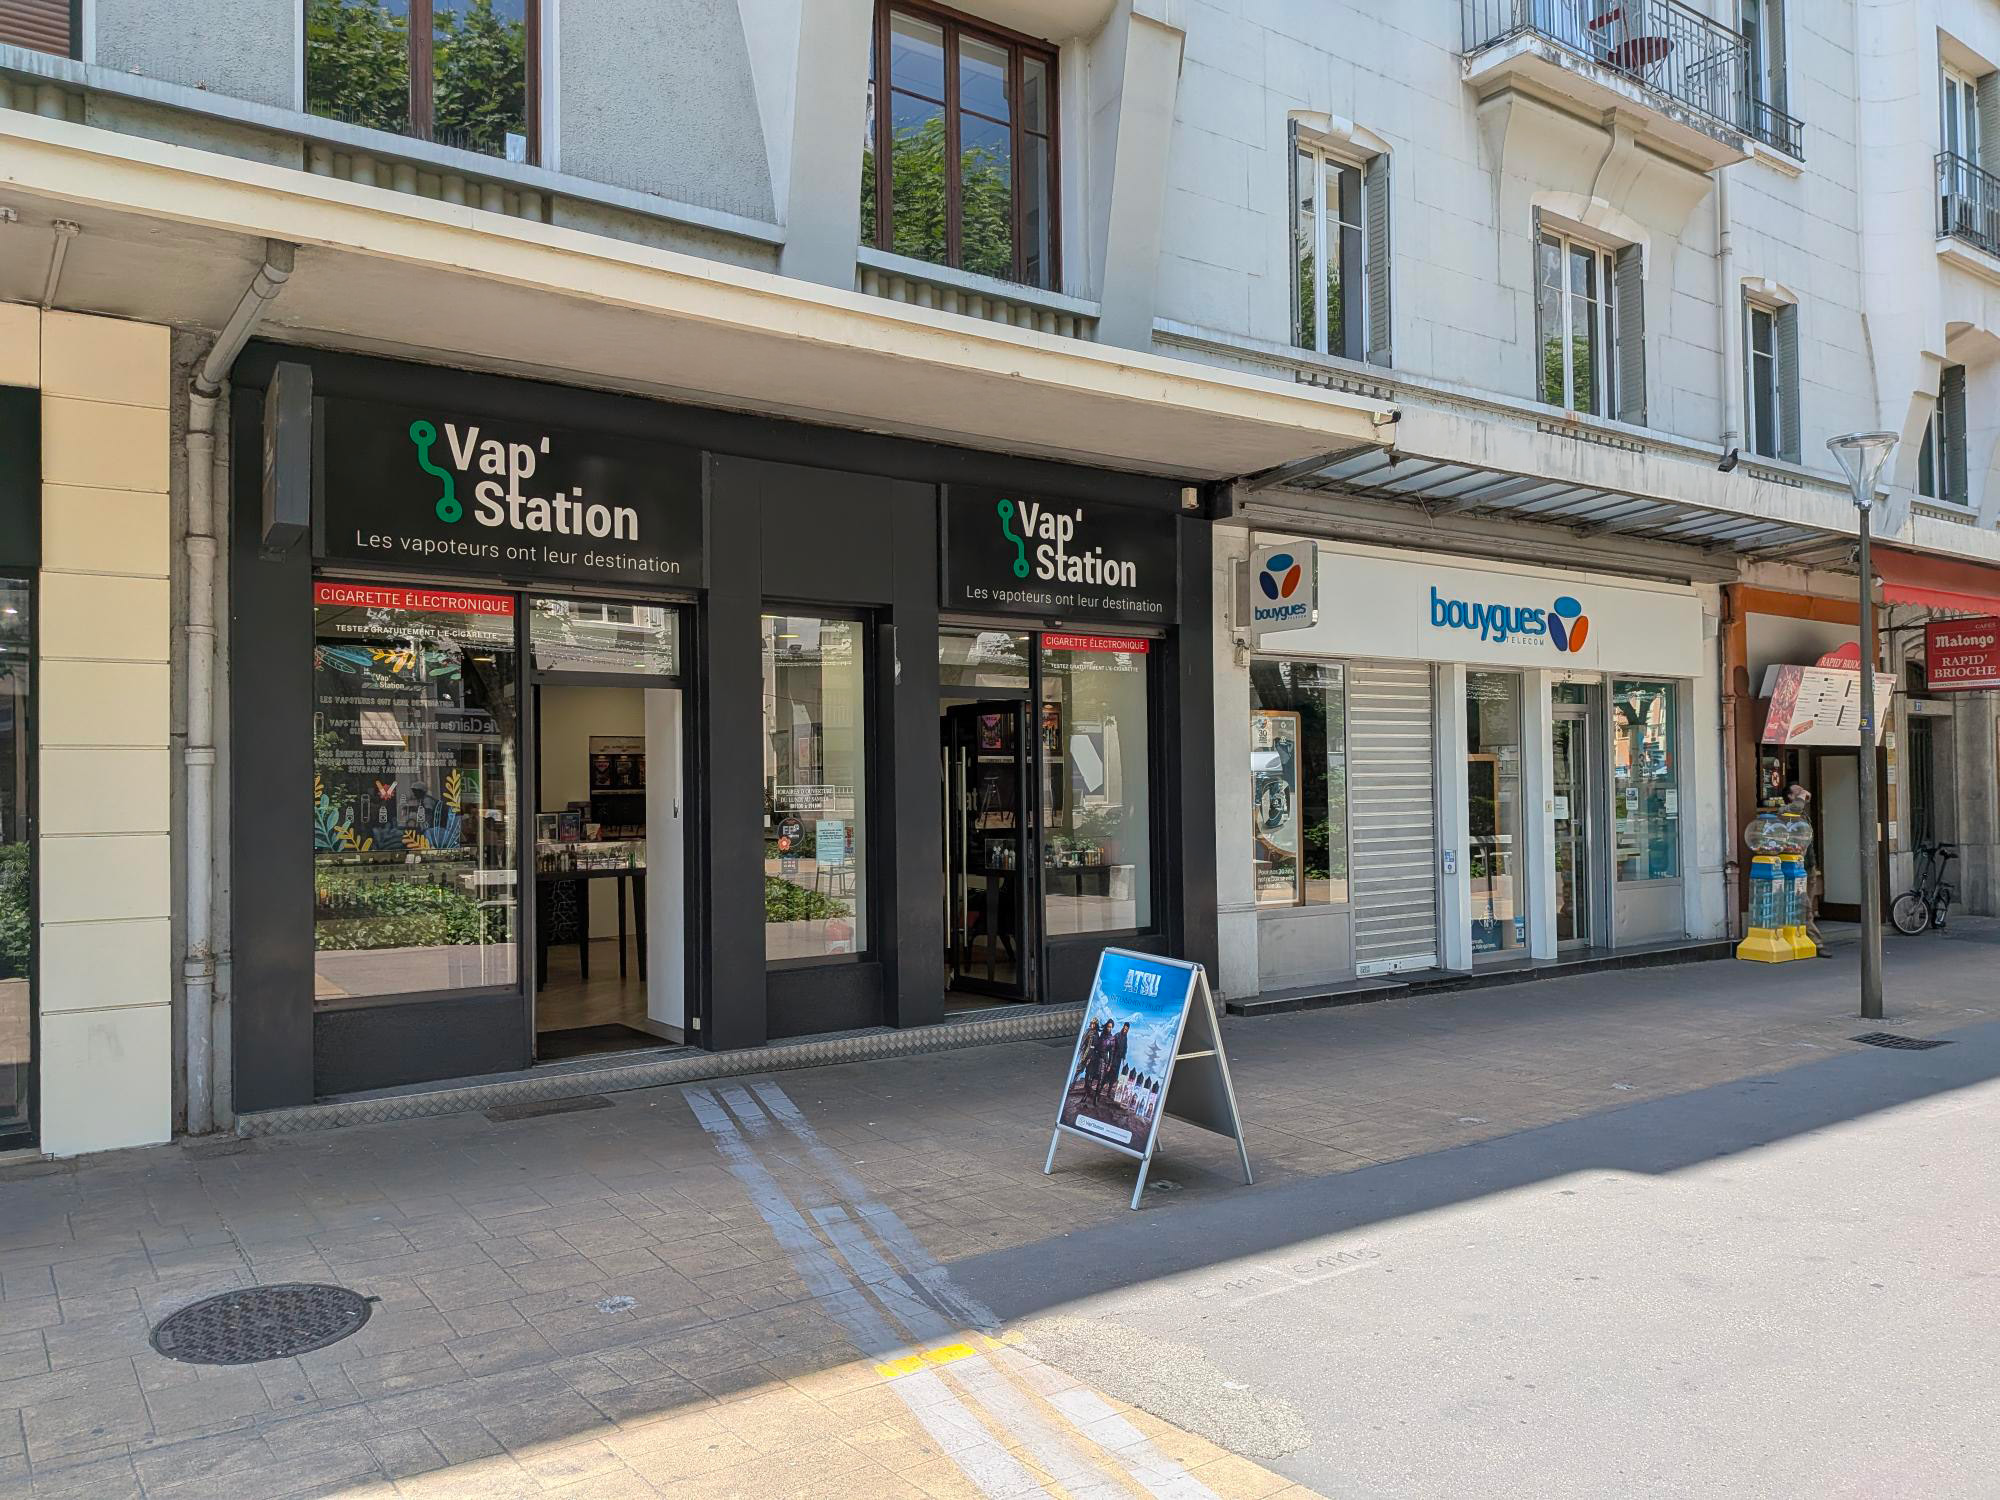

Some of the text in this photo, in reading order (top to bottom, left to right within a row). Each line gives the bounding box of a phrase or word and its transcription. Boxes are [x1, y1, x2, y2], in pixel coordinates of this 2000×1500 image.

[474, 480, 639, 541] Station
[356, 529, 681, 574] Les vapoteurs ont leur destination
[1036, 544, 1137, 588] Station
[320, 588, 509, 612] CIGARETTE ÉLECTRONIQUE
[966, 585, 1163, 613] Les vapoteurs ont leur destination
[1254, 603, 1307, 622] bouygues
[1430, 586, 1547, 643] bouygues
[336, 624, 369, 633] TESTEZ
[370, 626, 435, 636] GRATUITEMENT
[1045, 636, 1145, 650] CIGARETTE ÉLECTRONIQUE
[1506, 635, 1545, 646] TELECOM
[1935, 634, 1994, 648] Malongo
[1942, 654, 1988, 667] RAPID'
[1934, 666, 1997, 679] BRIOCHE
[380, 681, 405, 689] Station
[1123, 969, 1162, 997] ATSU
